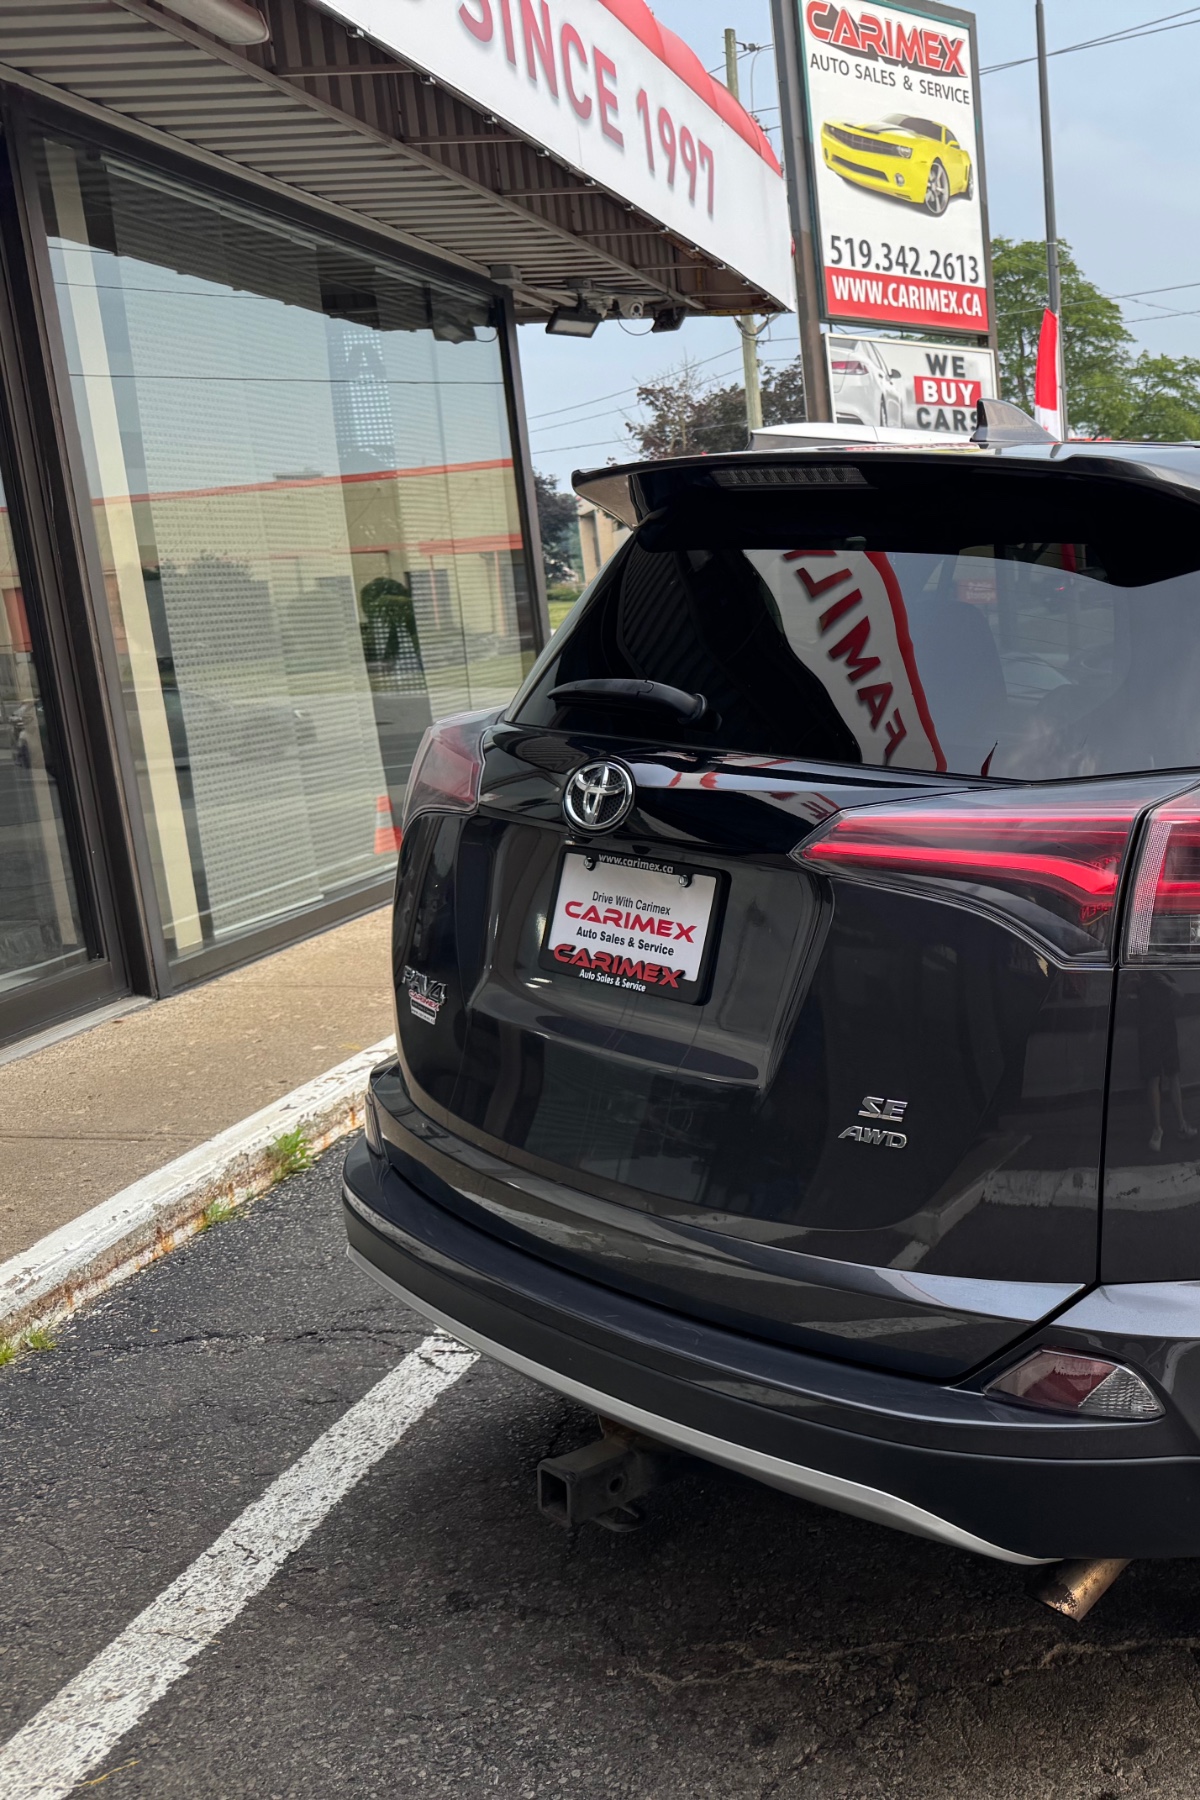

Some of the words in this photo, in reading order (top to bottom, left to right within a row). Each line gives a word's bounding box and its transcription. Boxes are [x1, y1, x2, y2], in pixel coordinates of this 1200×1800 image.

[805, 0, 968, 77] CARIMEX
[810, 53, 850, 76] AUTO
[855, 63, 896, 87] SALES
[903, 75, 914, 92] &
[919, 79, 970, 105] SERVICE
[637, 89, 714, 216] 1997
[830, 235, 979, 284] 519.342.2613
[831, 275, 983, 317] WWW.CARIMEX.CA
[926, 353, 966, 378] WE
[922, 380, 974, 405] BUY
[916, 407, 978, 432] CARS
[598, 854, 674, 874] www.carimex.ca
[592, 891, 613, 905] Drive
[615, 895, 634, 909] With
[635, 899, 671, 916] Carimex
[564, 900, 698, 944] CARIMEX
[576, 926, 598, 940] Auto
[599, 930, 625, 946] Sales
[627, 936, 635, 947] &
[637, 938, 675, 956] Service
[553, 943, 685, 988] CARIMEX
[579, 969, 596, 981] Auto
[596, 973, 615, 985] Sales
[614, 976, 621, 986] &
[621, 977, 647, 993] Service
[857, 1095, 908, 1123] SE
[837, 1125, 908, 1149] AWD
